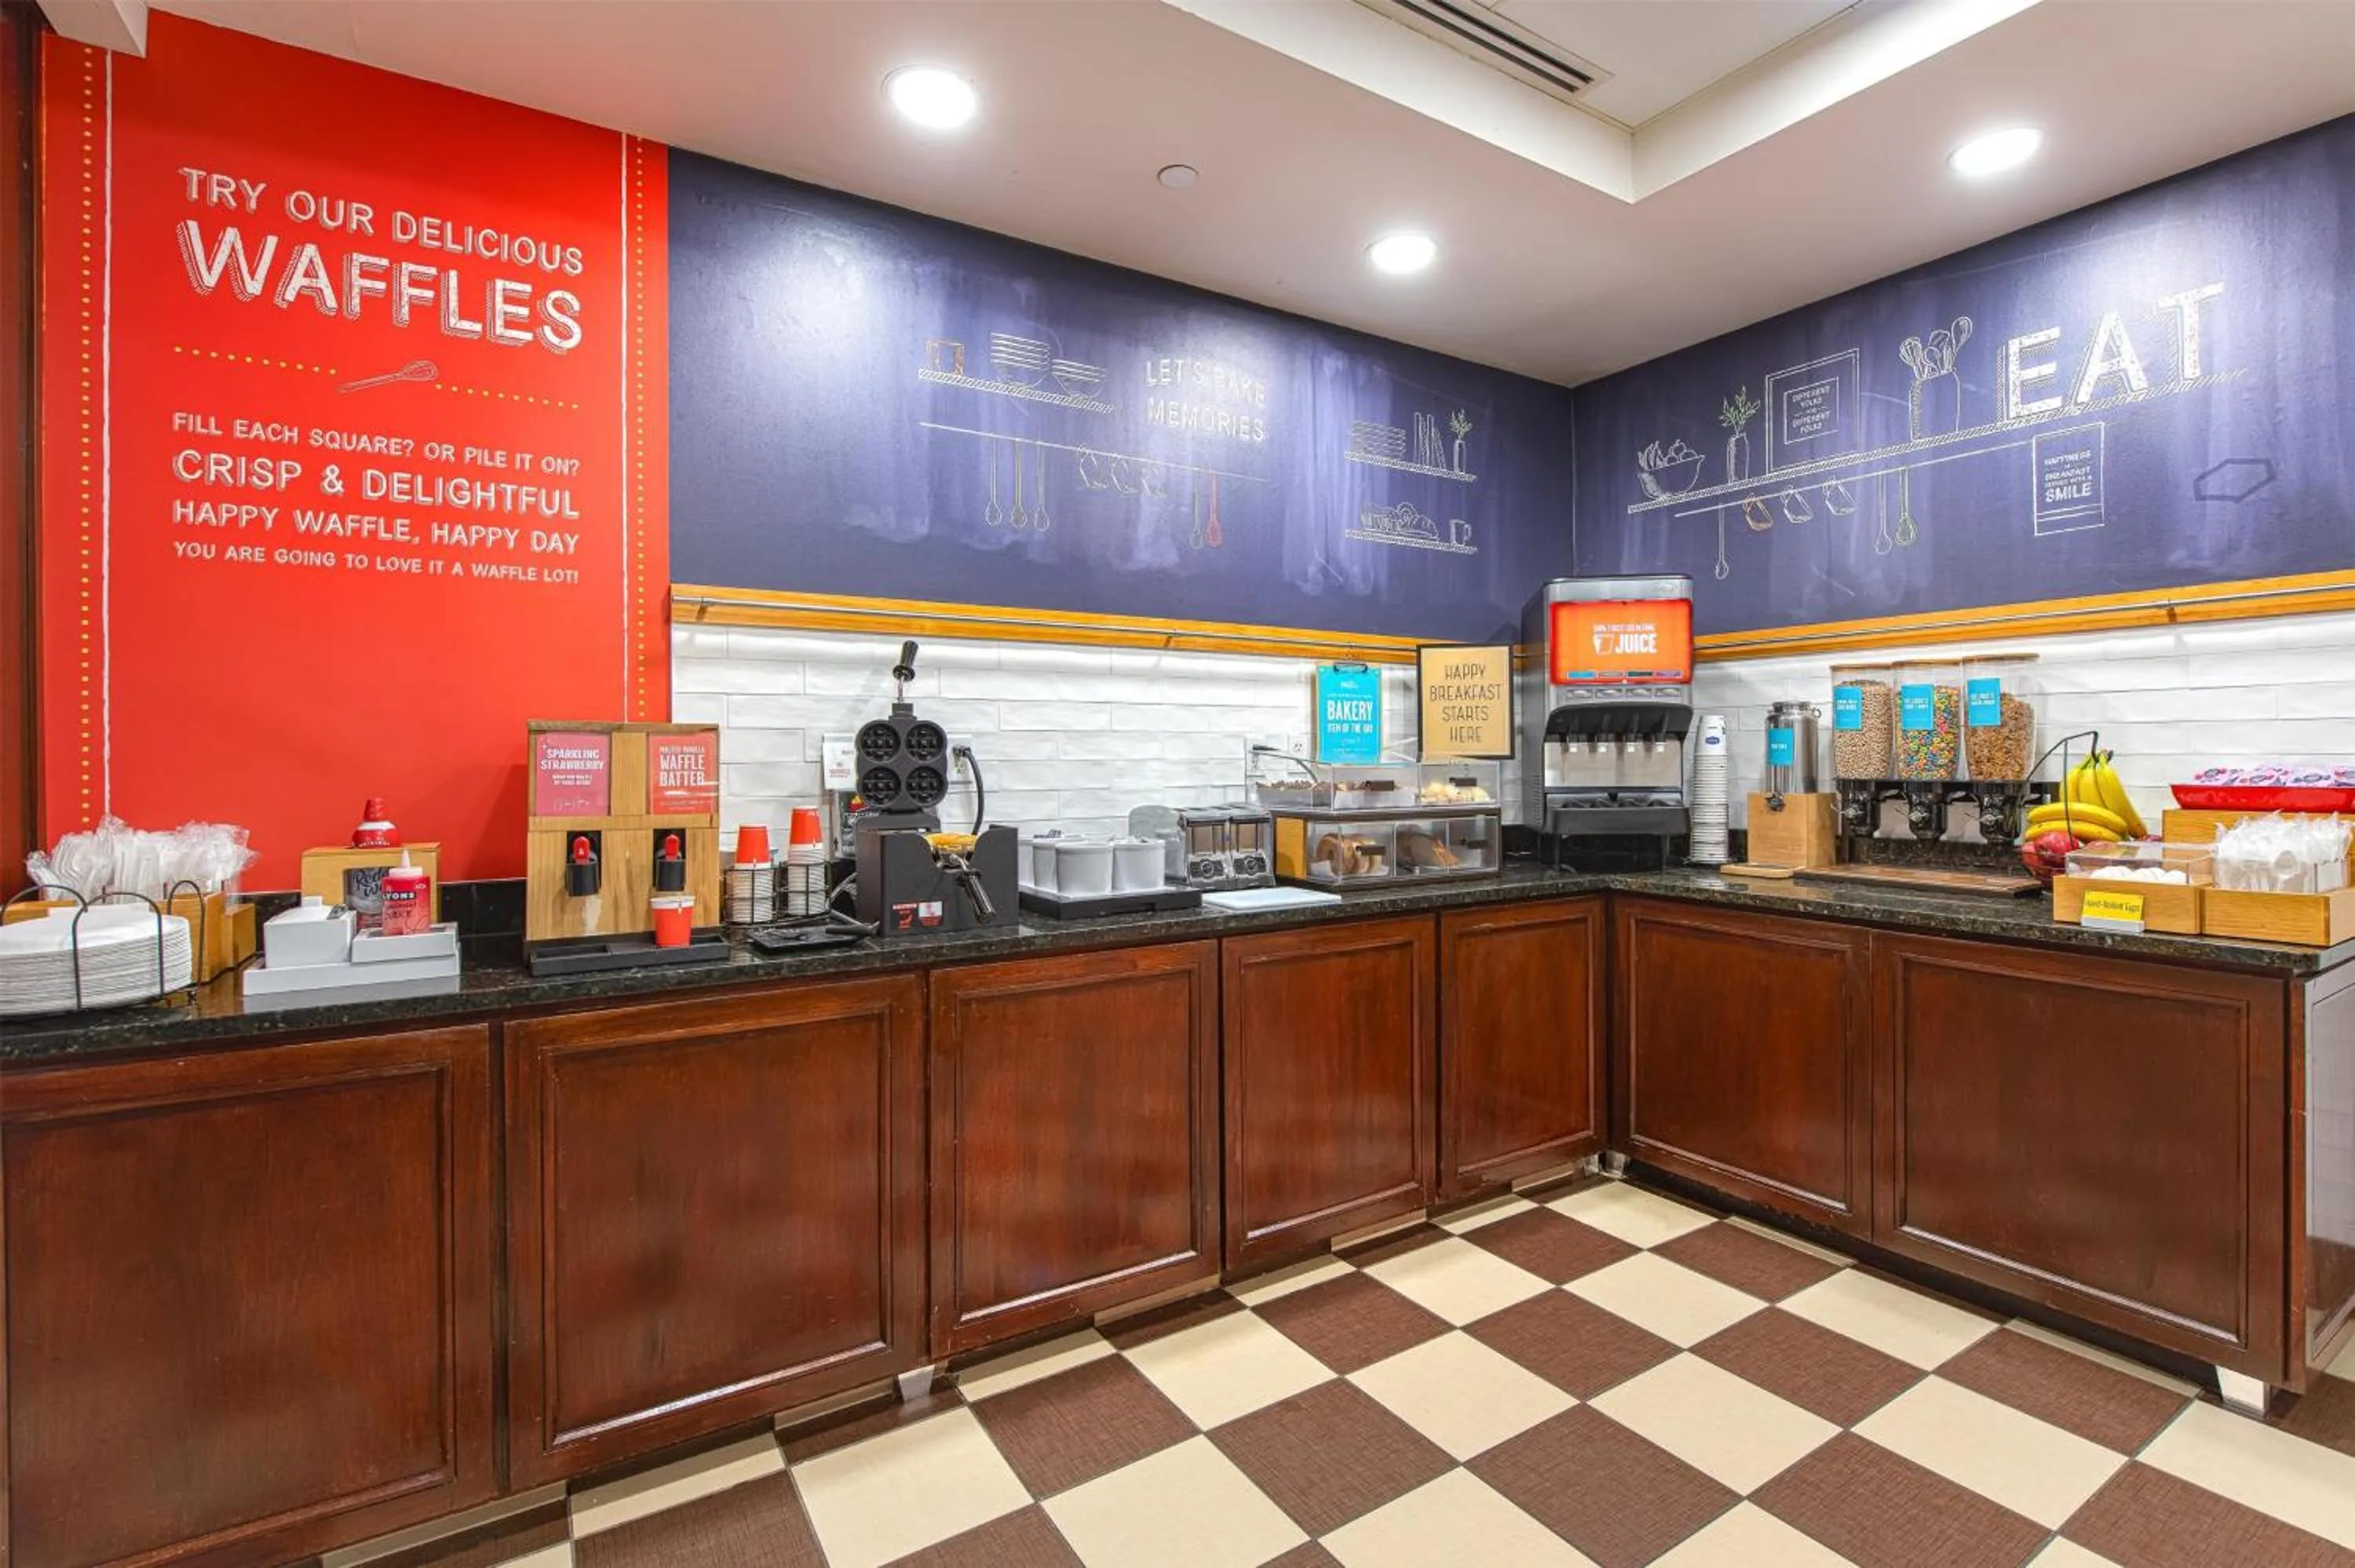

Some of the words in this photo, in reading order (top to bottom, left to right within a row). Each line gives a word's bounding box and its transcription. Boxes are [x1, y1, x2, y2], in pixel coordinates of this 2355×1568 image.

[178, 167, 267, 213] TRY
[285, 191, 374, 235] OUR
[392, 211, 584, 277] DELICIOUS
[176, 219, 583, 355] WAFFLES
[1997, 281, 2225, 424] EAT
[1145, 357, 1207, 387] LET'S
[1146, 396, 1268, 443] MEMORIES
[172, 412, 223, 436] FILL
[233, 418, 299, 445] EACH
[309, 428, 414, 458] SQUARE?
[425, 442, 455, 462] OR
[465, 447, 508, 470] PILE
[515, 454, 533, 472] IT
[541, 456, 581, 476] ON?
[173, 449, 302, 490] CRISP
[321, 464, 345, 495] &
[363, 469, 580, 519] DELIGHTFUL
[2045, 483, 2093, 503] SMILE
[173, 500, 279, 531] HAPPY
[293, 509, 420, 544] WAFFLE,
[431, 522, 519, 549] HAPPY
[530, 531, 579, 554] DAY
[173, 541, 216, 560] YOU
[225, 545, 265, 563] ARE
[275, 548, 336, 567] GOING
[345, 553, 368, 570] TO
[376, 556, 422, 574] LOVE
[429, 560, 445, 575] IT
[451, 561, 465, 577] A
[471, 563, 538, 582] WAFFLE
[543, 567, 579, 585] LOT!
[1615, 633, 1657, 654] JUICE
[1444, 663, 1486, 680] HAPPY
[1429, 684, 1502, 702] BREAKFAST
[1327, 699, 1373, 721] BAKERY
[1442, 706, 1489, 722] STARTS
[1450, 726, 1483, 743] HERE
[546, 748, 600, 759] SPARKLING
[660, 754, 704, 770] WAFFLE
[540, 759, 604, 770] STRAWBERRY
[659, 771, 704, 787] BATTER
[383, 892, 416, 901] LYONS
